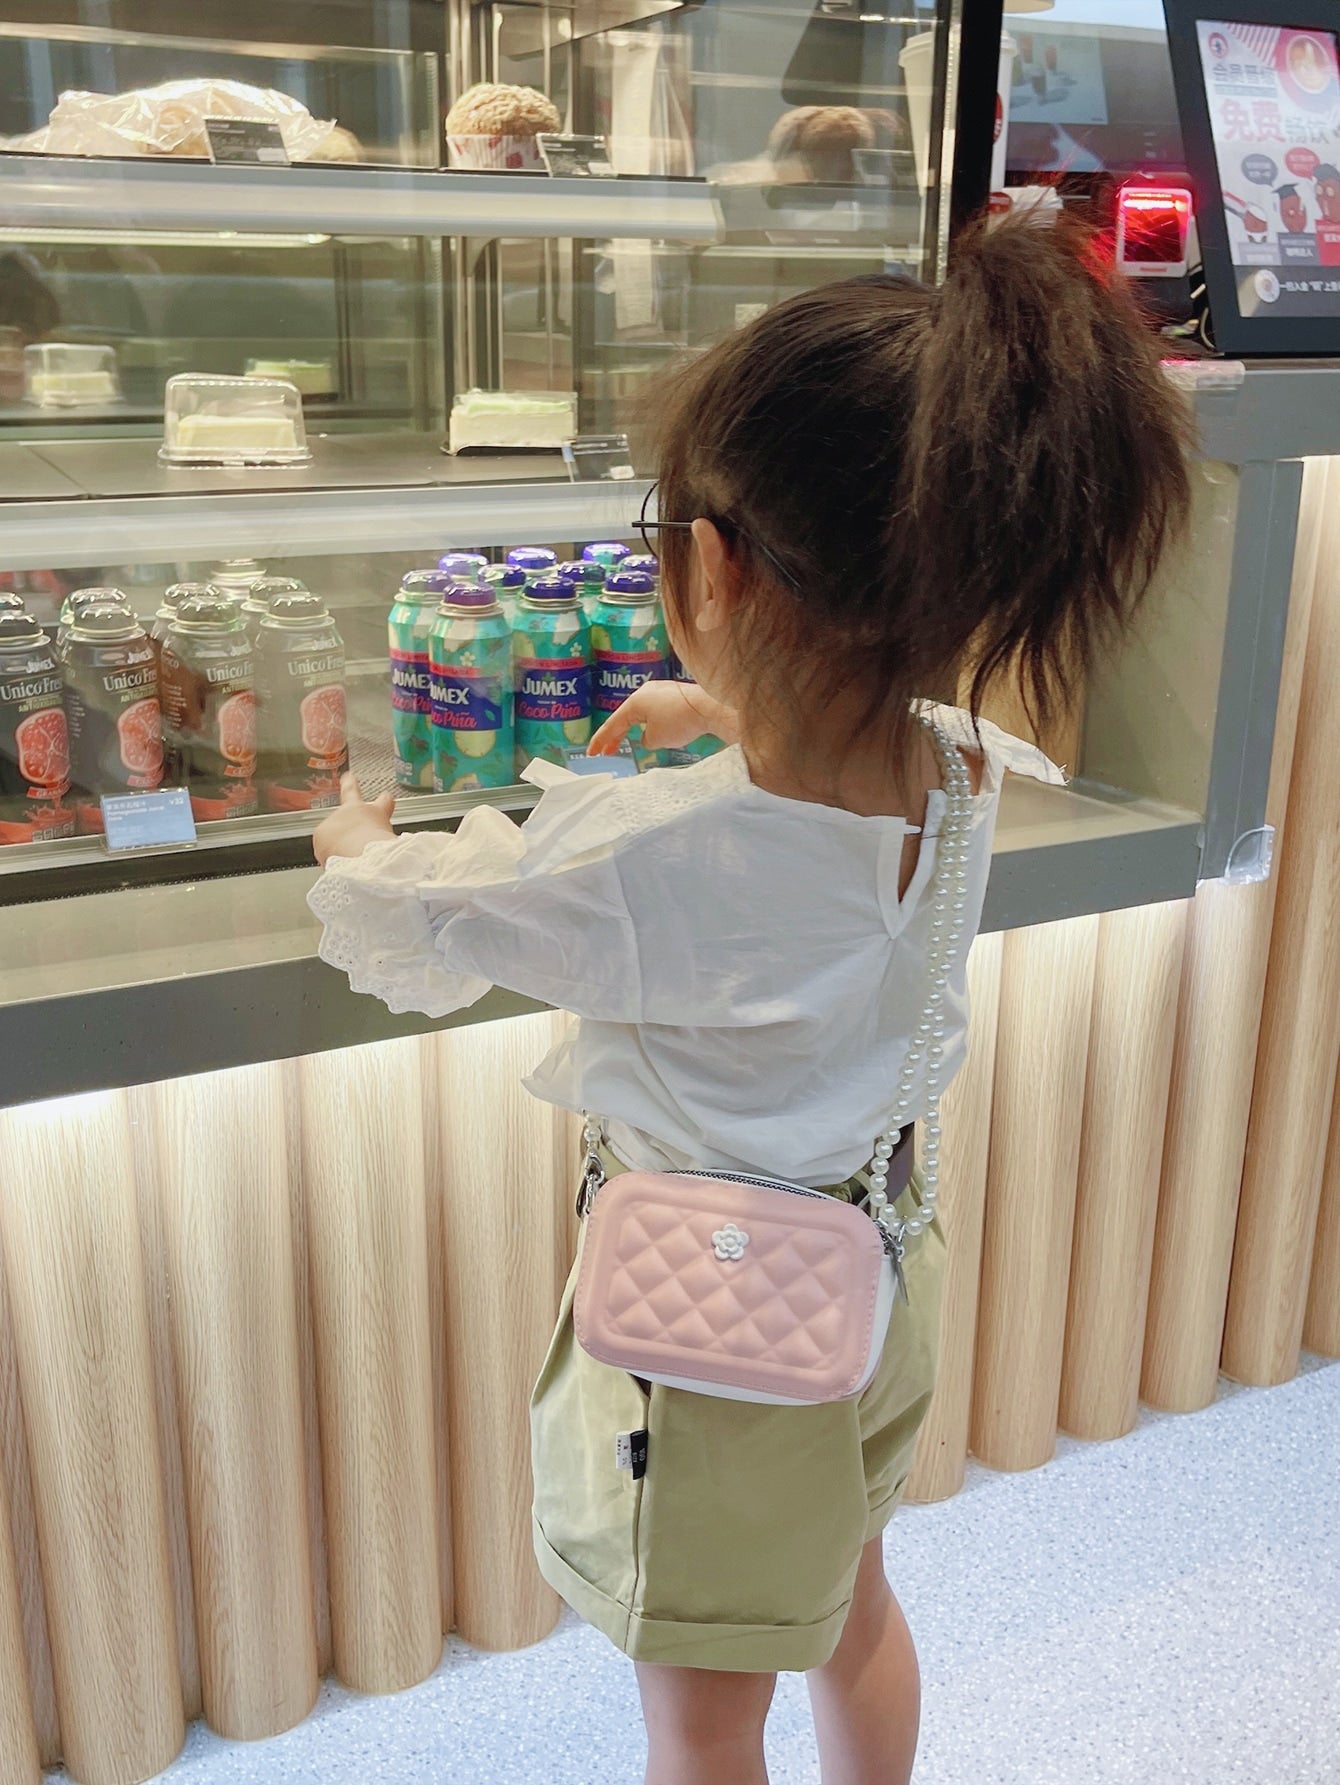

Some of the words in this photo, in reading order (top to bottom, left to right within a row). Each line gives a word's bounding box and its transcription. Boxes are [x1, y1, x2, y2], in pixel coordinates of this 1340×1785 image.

[522, 677, 578, 697] JUMEX
[519, 701, 550, 719] Coco
[551, 701, 581, 719] Piña
[443, 711, 477, 729] Piña
